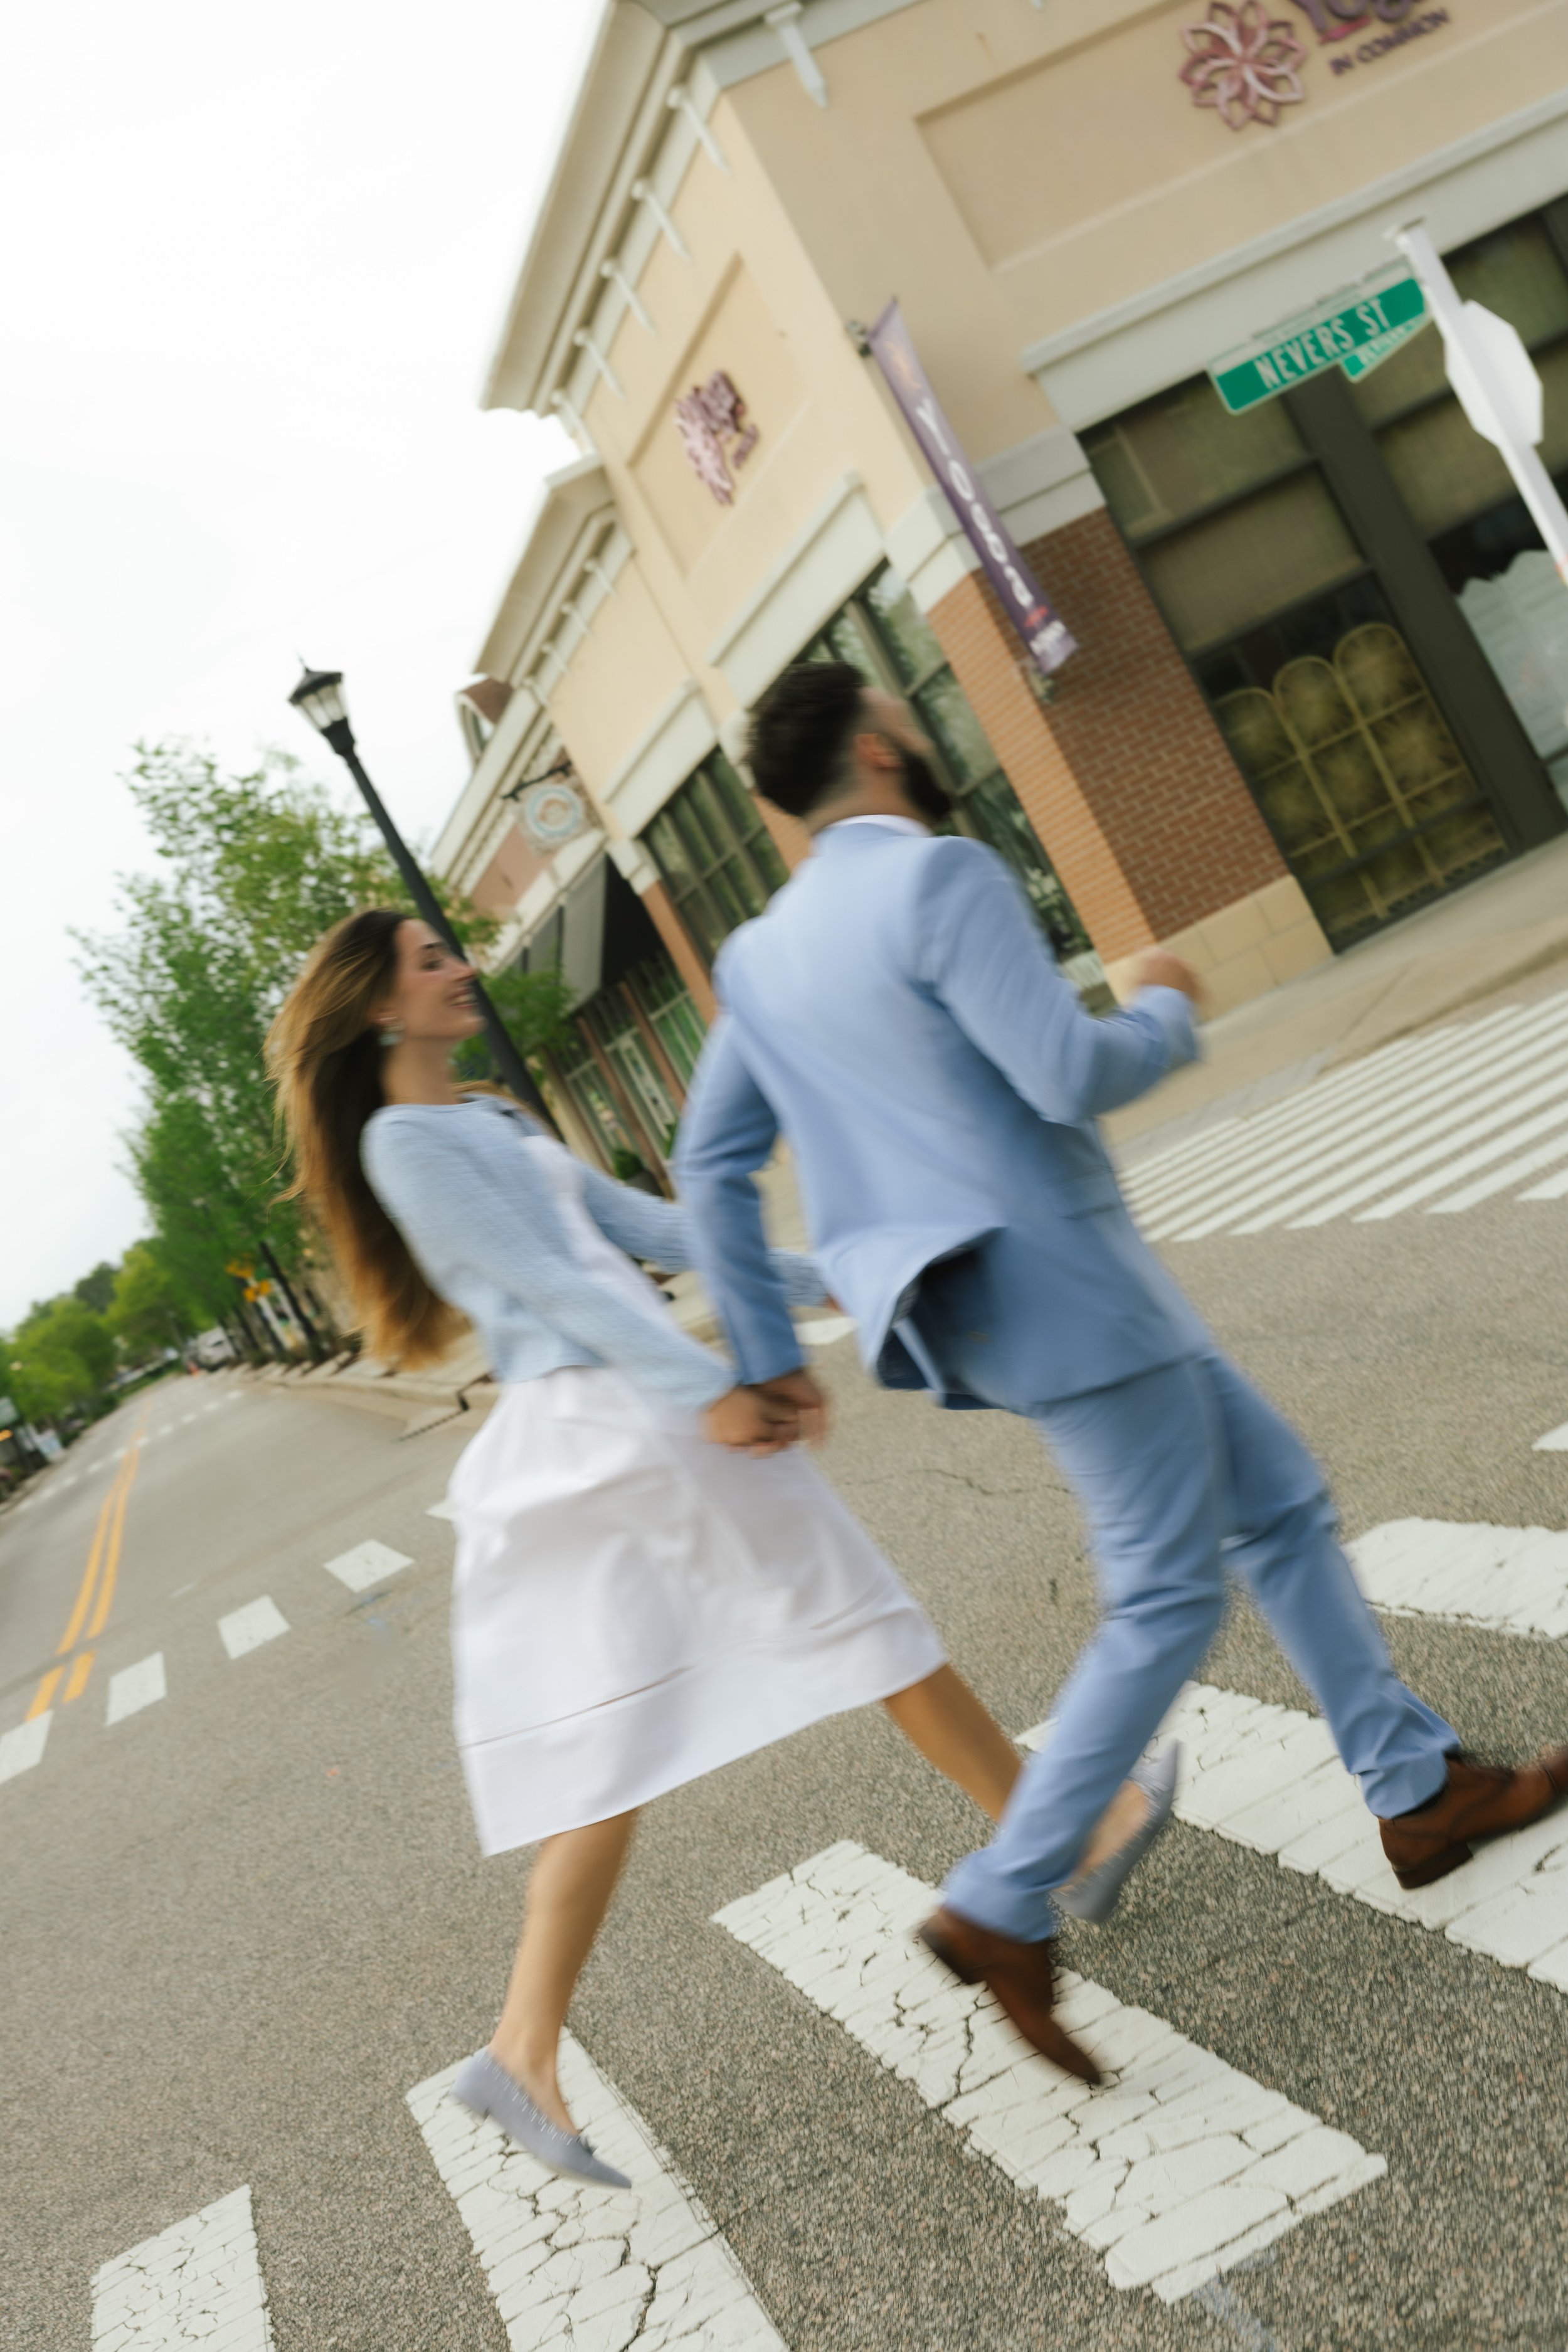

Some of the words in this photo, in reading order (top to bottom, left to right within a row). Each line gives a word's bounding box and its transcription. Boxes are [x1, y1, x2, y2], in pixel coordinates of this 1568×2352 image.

[1329, 54, 1354, 76] IN
[1356, 6, 1448, 63] COMMON
[1253, 318, 1355, 389] NEVERS
[1355, 298, 1391, 337] ST
